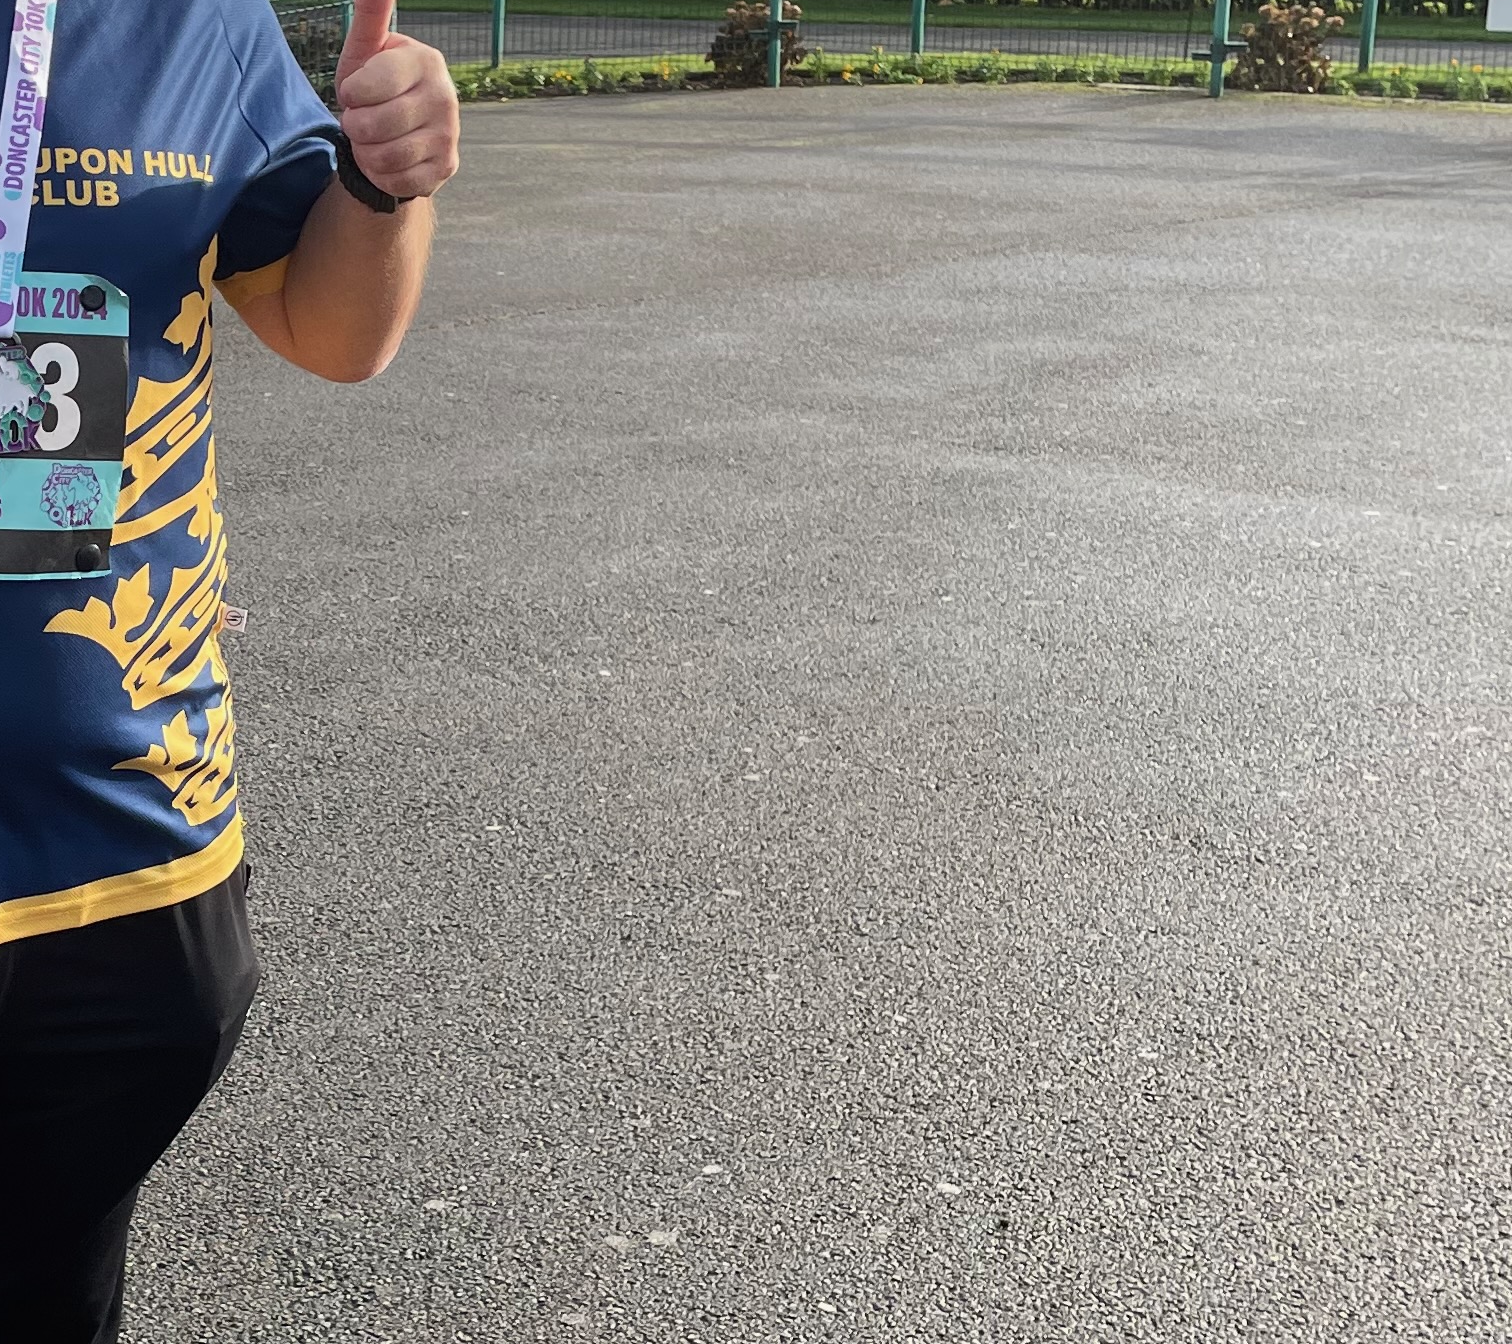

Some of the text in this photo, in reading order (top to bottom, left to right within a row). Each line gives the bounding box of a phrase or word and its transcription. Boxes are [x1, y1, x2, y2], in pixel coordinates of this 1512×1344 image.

[24, 4, 46, 32] 10K
[19, 35, 40, 77] CITY
[3, 78, 38, 190] DONCASTER
[144, 150, 214, 183] HULL
